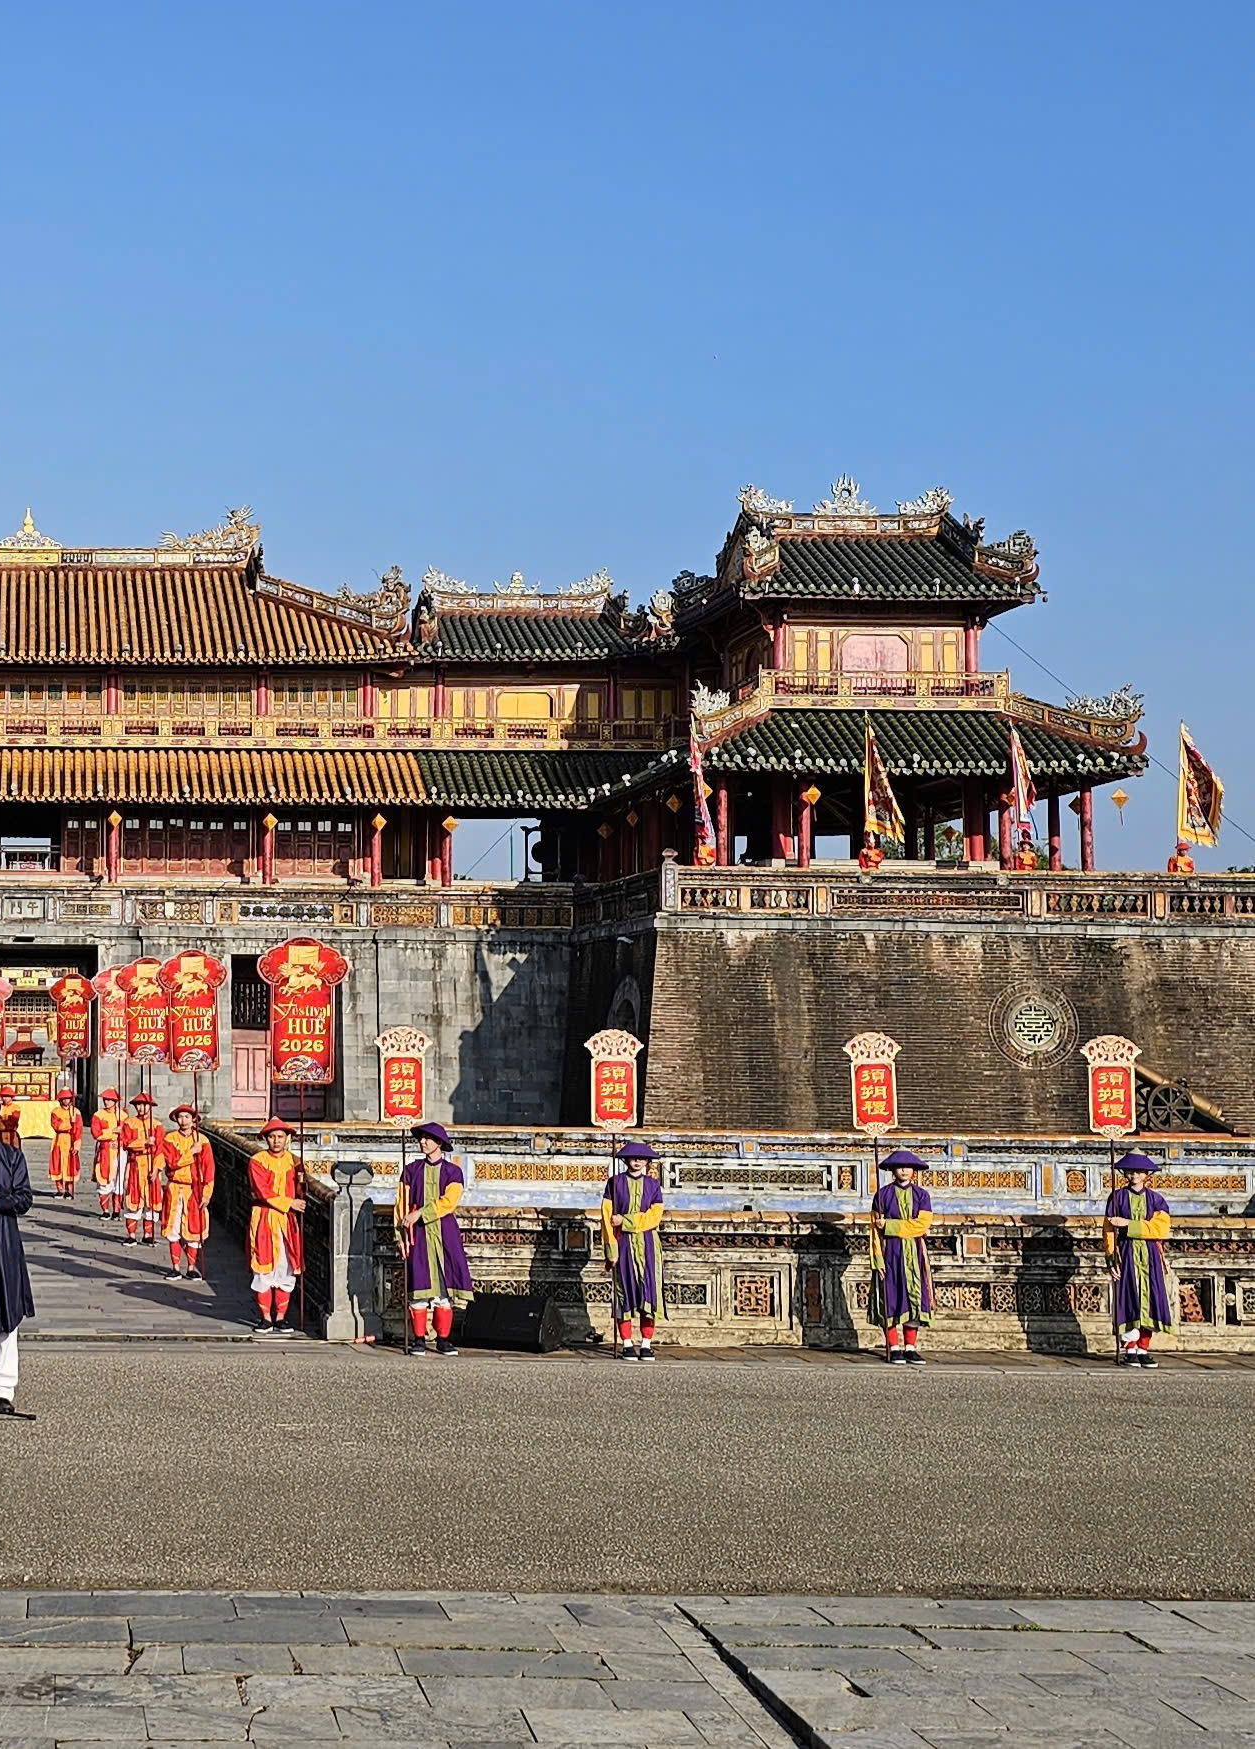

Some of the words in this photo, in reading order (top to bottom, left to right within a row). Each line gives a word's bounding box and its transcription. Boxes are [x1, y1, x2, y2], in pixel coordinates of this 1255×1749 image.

[170, 1000, 215, 1022] Festival
[273, 995, 330, 1022] Festival
[105, 1030, 126, 1040] 202
[132, 1031, 165, 1042] 2026
[176, 1034, 212, 1047] 2026
[279, 1038, 324, 1052] 2026
